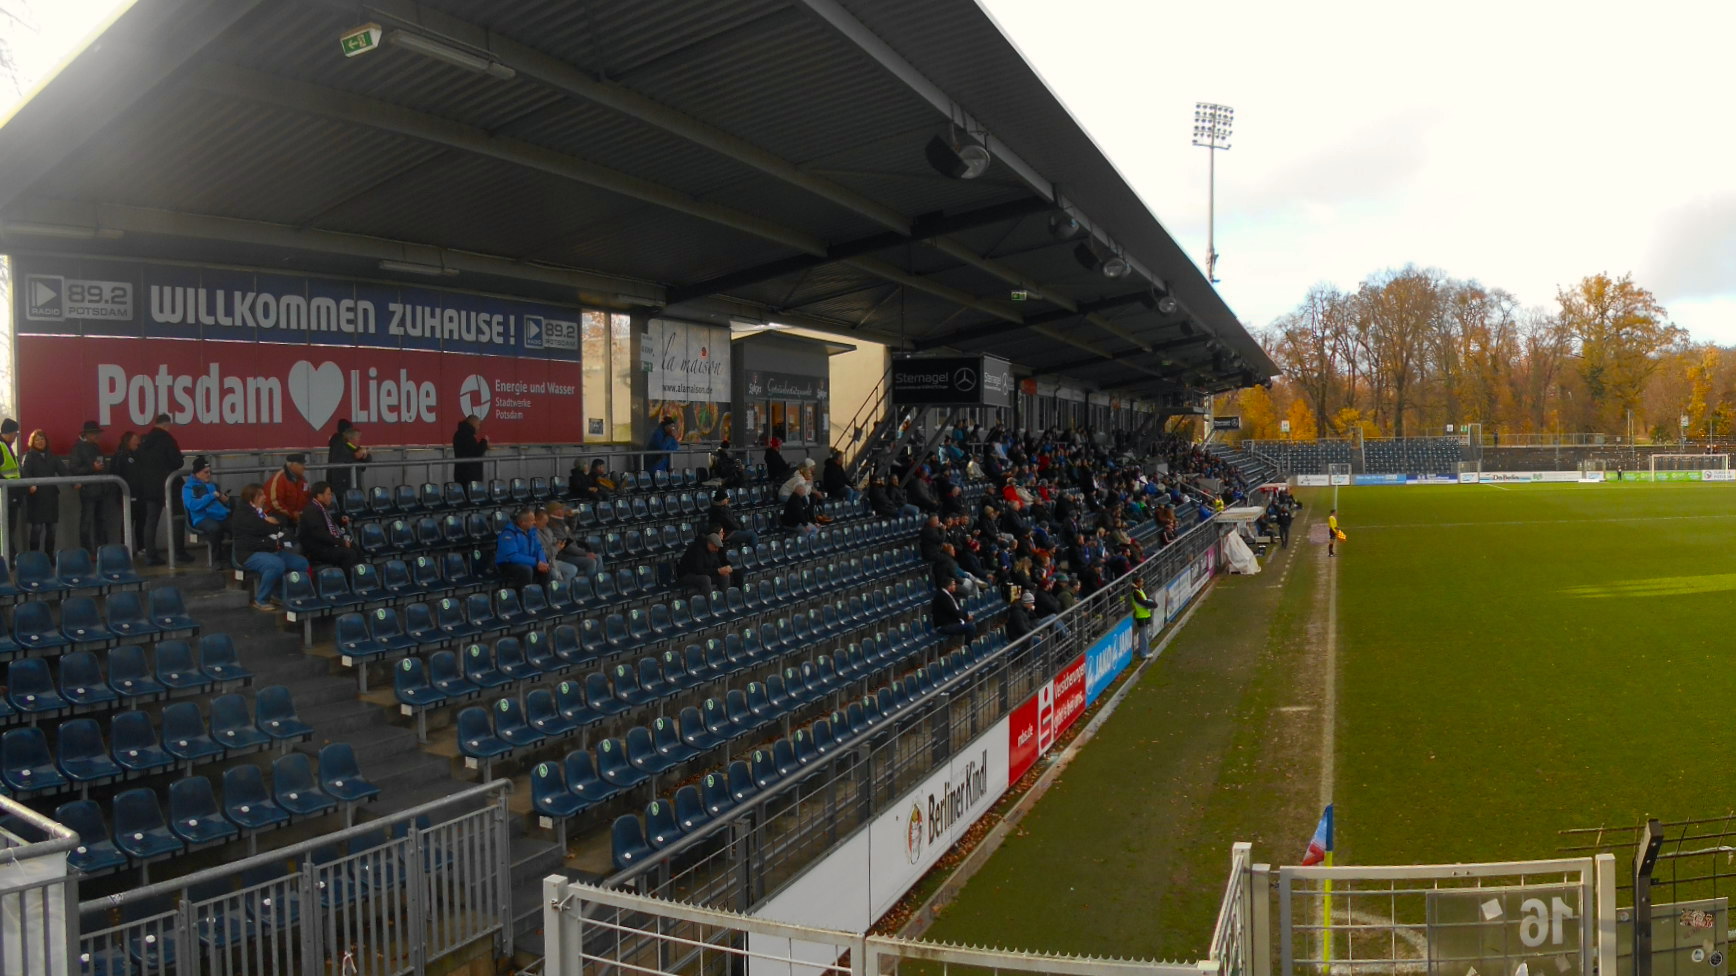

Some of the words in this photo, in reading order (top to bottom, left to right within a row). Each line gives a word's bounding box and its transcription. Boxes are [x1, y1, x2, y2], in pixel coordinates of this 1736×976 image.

[68, 284, 128, 305] 89.2
[31, 307, 60, 316] RADIO
[68, 306, 128, 318] POTSDAM
[150, 284, 376, 334] WILLKOMMEN
[545, 322, 576, 338] 89.2
[661, 332, 676, 371] la
[680, 356, 722, 376] maison
[895, 371, 948, 385] Sternagel
[98, 362, 282, 427] Potsdam
[350, 367, 438, 424] Liebe
[495, 379, 527, 395] Energie
[530, 382, 545, 394] und
[547, 383, 575, 395] Wasser
[662, 383, 713, 395] www.alamaison.de
[495, 397, 531, 408] Stadtwerke
[495, 409, 523, 420] Potsdam
[928, 781, 965, 846] Berliner
[965, 748, 987, 812] Kindl
